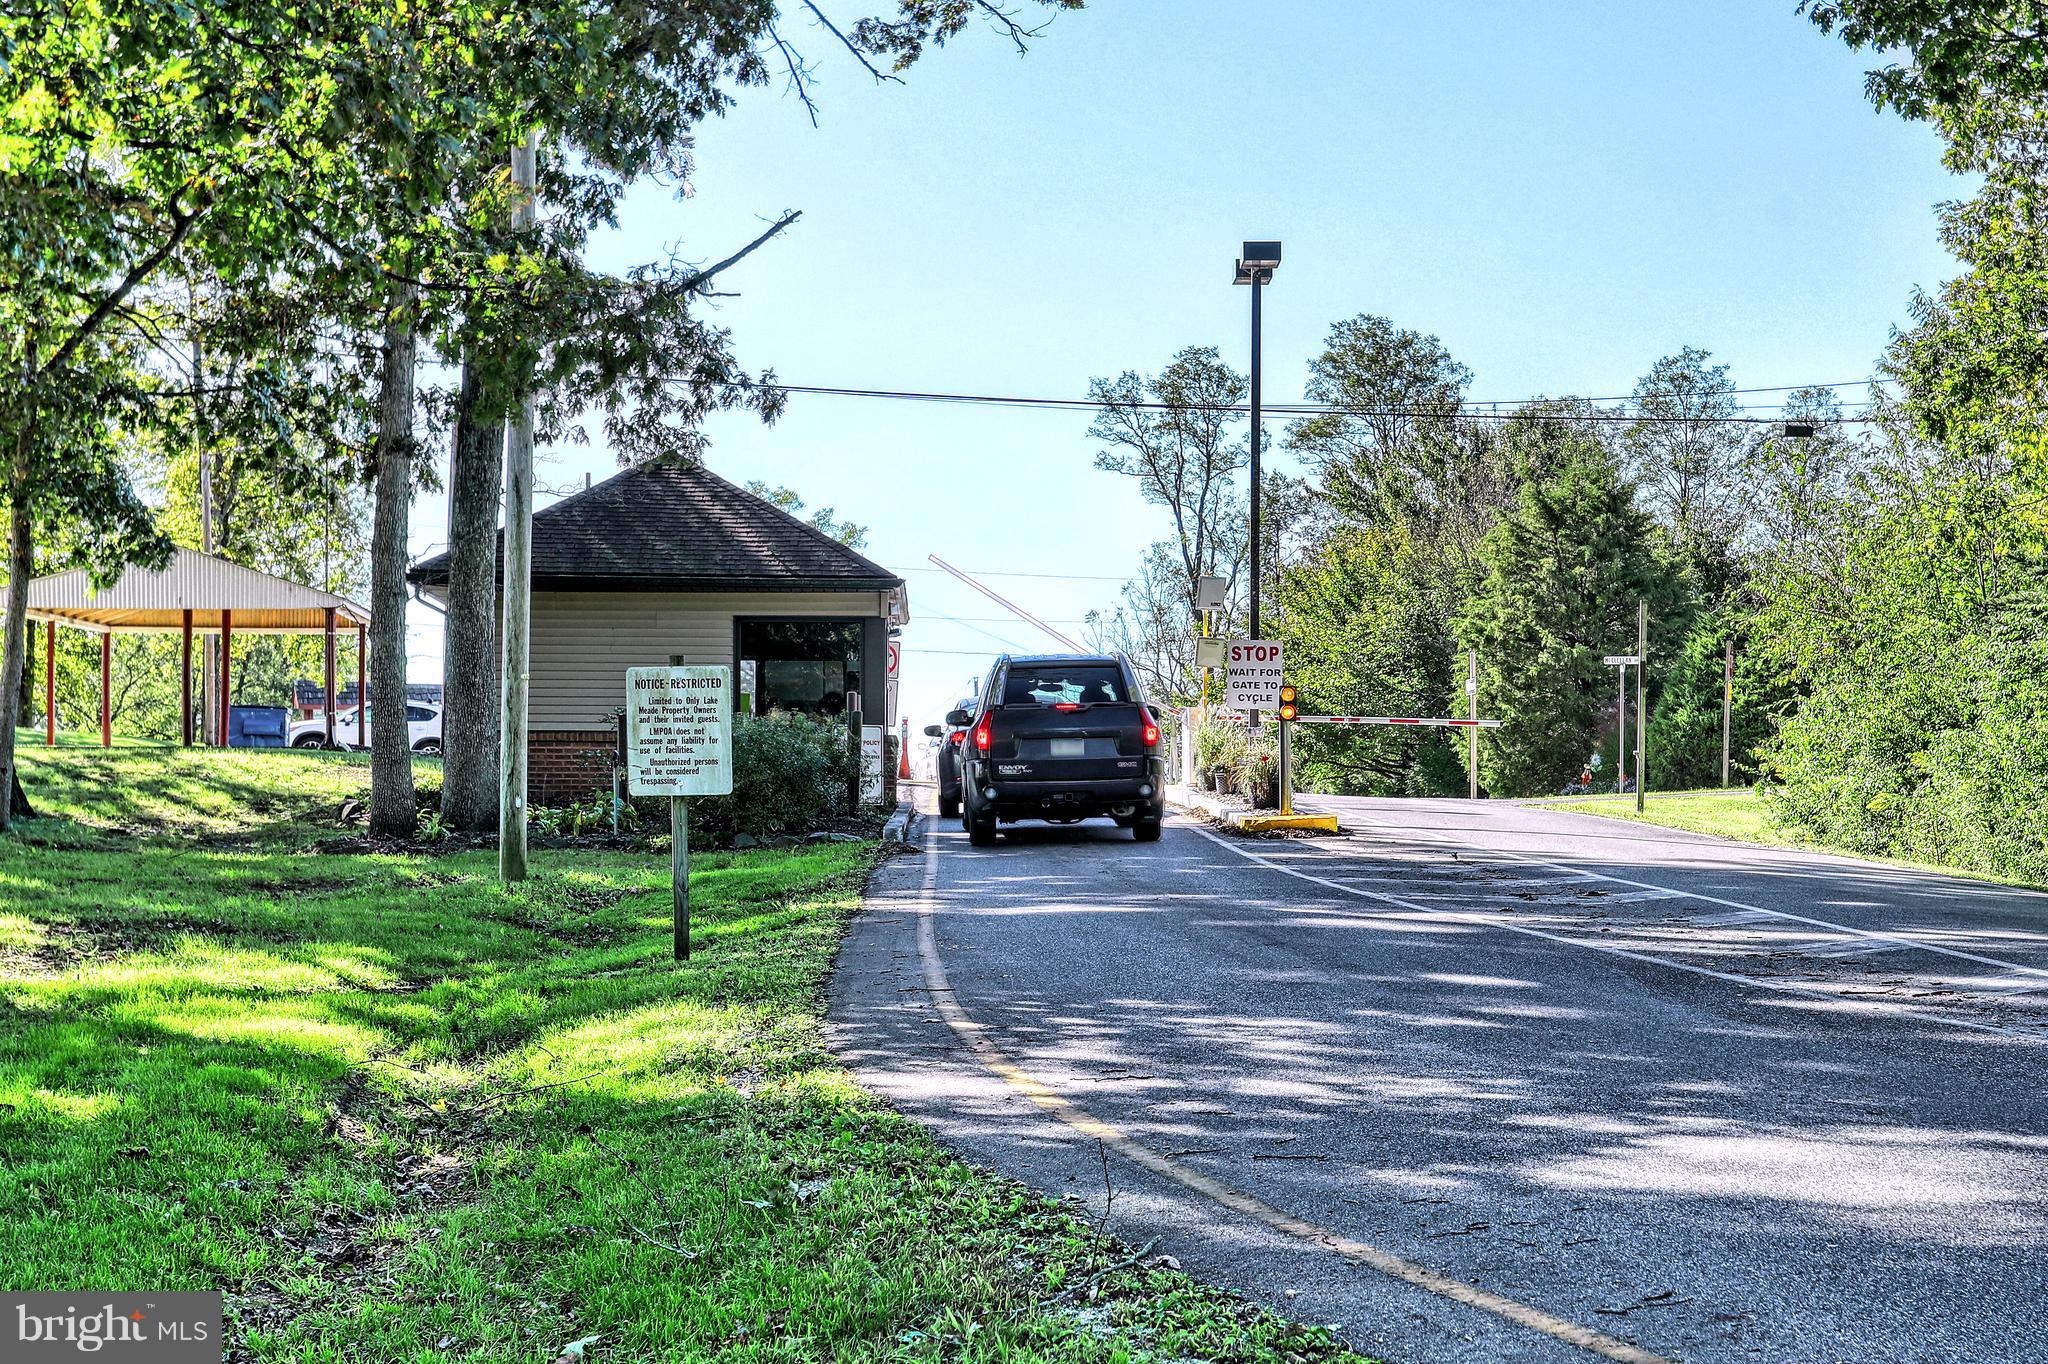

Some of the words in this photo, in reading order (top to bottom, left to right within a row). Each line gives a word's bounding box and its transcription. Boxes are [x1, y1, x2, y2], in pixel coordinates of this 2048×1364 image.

[1231, 646, 1280, 662] STOP
[1229, 668, 1256, 677] WAIT
[1260, 668, 1281, 677] FOR
[1232, 681, 1261, 689] GATE
[1264, 681, 1278, 689] TO
[648, 697, 672, 705] Limited
[676, 697, 682, 705] to
[686, 697, 700, 707] Only
[703, 697, 718, 705] Lake
[1238, 694, 1273, 702] CYCLE
[638, 707, 659, 715] Meade
[662, 706, 690, 716] Property
[693, 706, 717, 714] Owners
[639, 716, 650, 724] and
[672, 715, 694, 723] invited
[697, 716, 720, 725] guests.
[676, 727, 691, 735] does
[667, 738, 678, 746] any
[681, 736, 705, 746] liability
[709, 736, 719, 744] for
[655, 746, 662, 754] of
[665, 746, 695, 754] facilities.
[650, 758, 691, 766] Unauthorized
[694, 759, 719, 767] persons
[640, 767, 651, 776] will
[655, 767, 663, 775] be
[666, 767, 700, 775] considered
[640, 777, 679, 786] trespassing.
